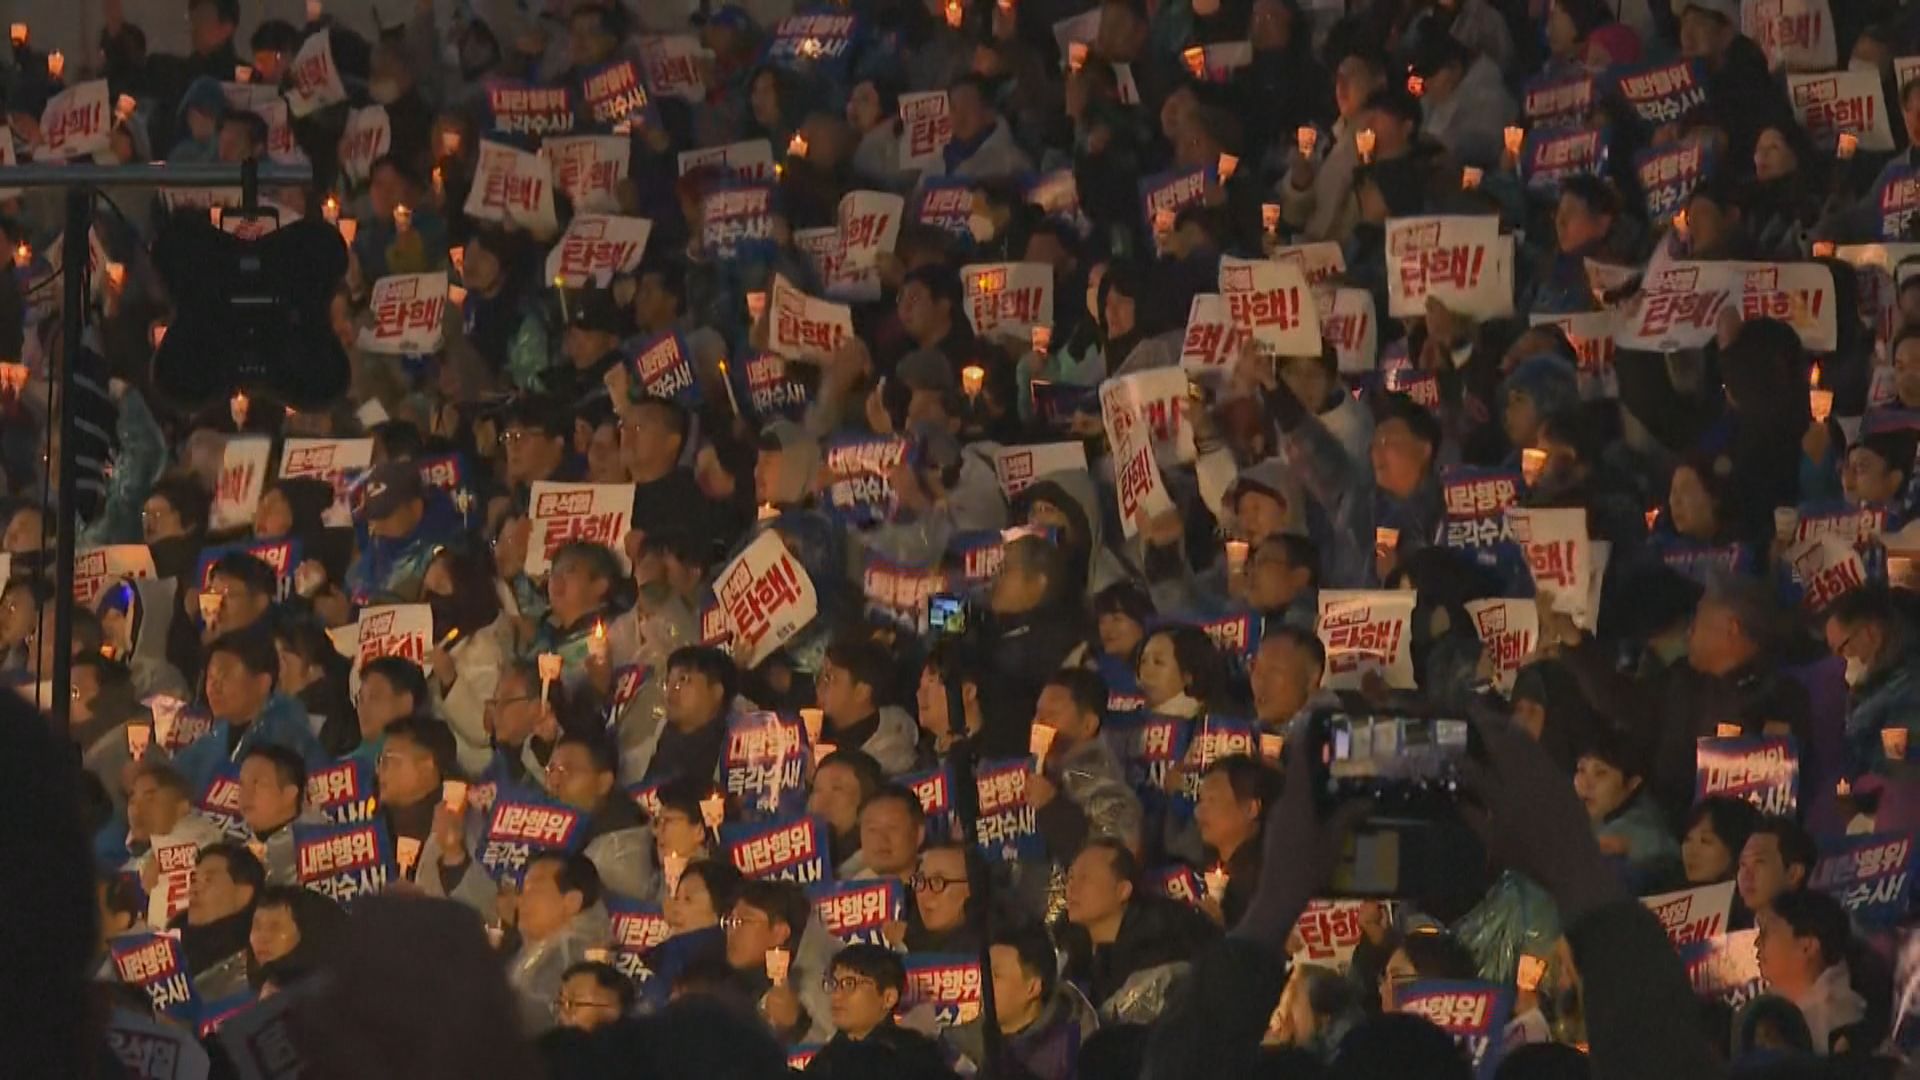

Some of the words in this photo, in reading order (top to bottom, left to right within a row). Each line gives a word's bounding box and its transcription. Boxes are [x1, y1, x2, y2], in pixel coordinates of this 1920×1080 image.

[1400, 245, 1485, 297] 탄핵!
[1530, 541, 1576, 587] 핵!
[733, 553, 802, 647] 탄핵!
[1327, 618, 1403, 674] 탄핵!
[307, 762, 355, 804] 행위
[977, 767, 1026, 816] 란행위
[495, 802, 574, 844] 내란행위
[301, 828, 376, 876] 내란행위
[734, 820, 813, 875] 내란행위
[1843, 870, 1907, 910] 수사!
[1298, 907, 1361, 960] 탄핵
[117, 939, 175, 984] 내란행위
[147, 972, 191, 1012] 수사!
